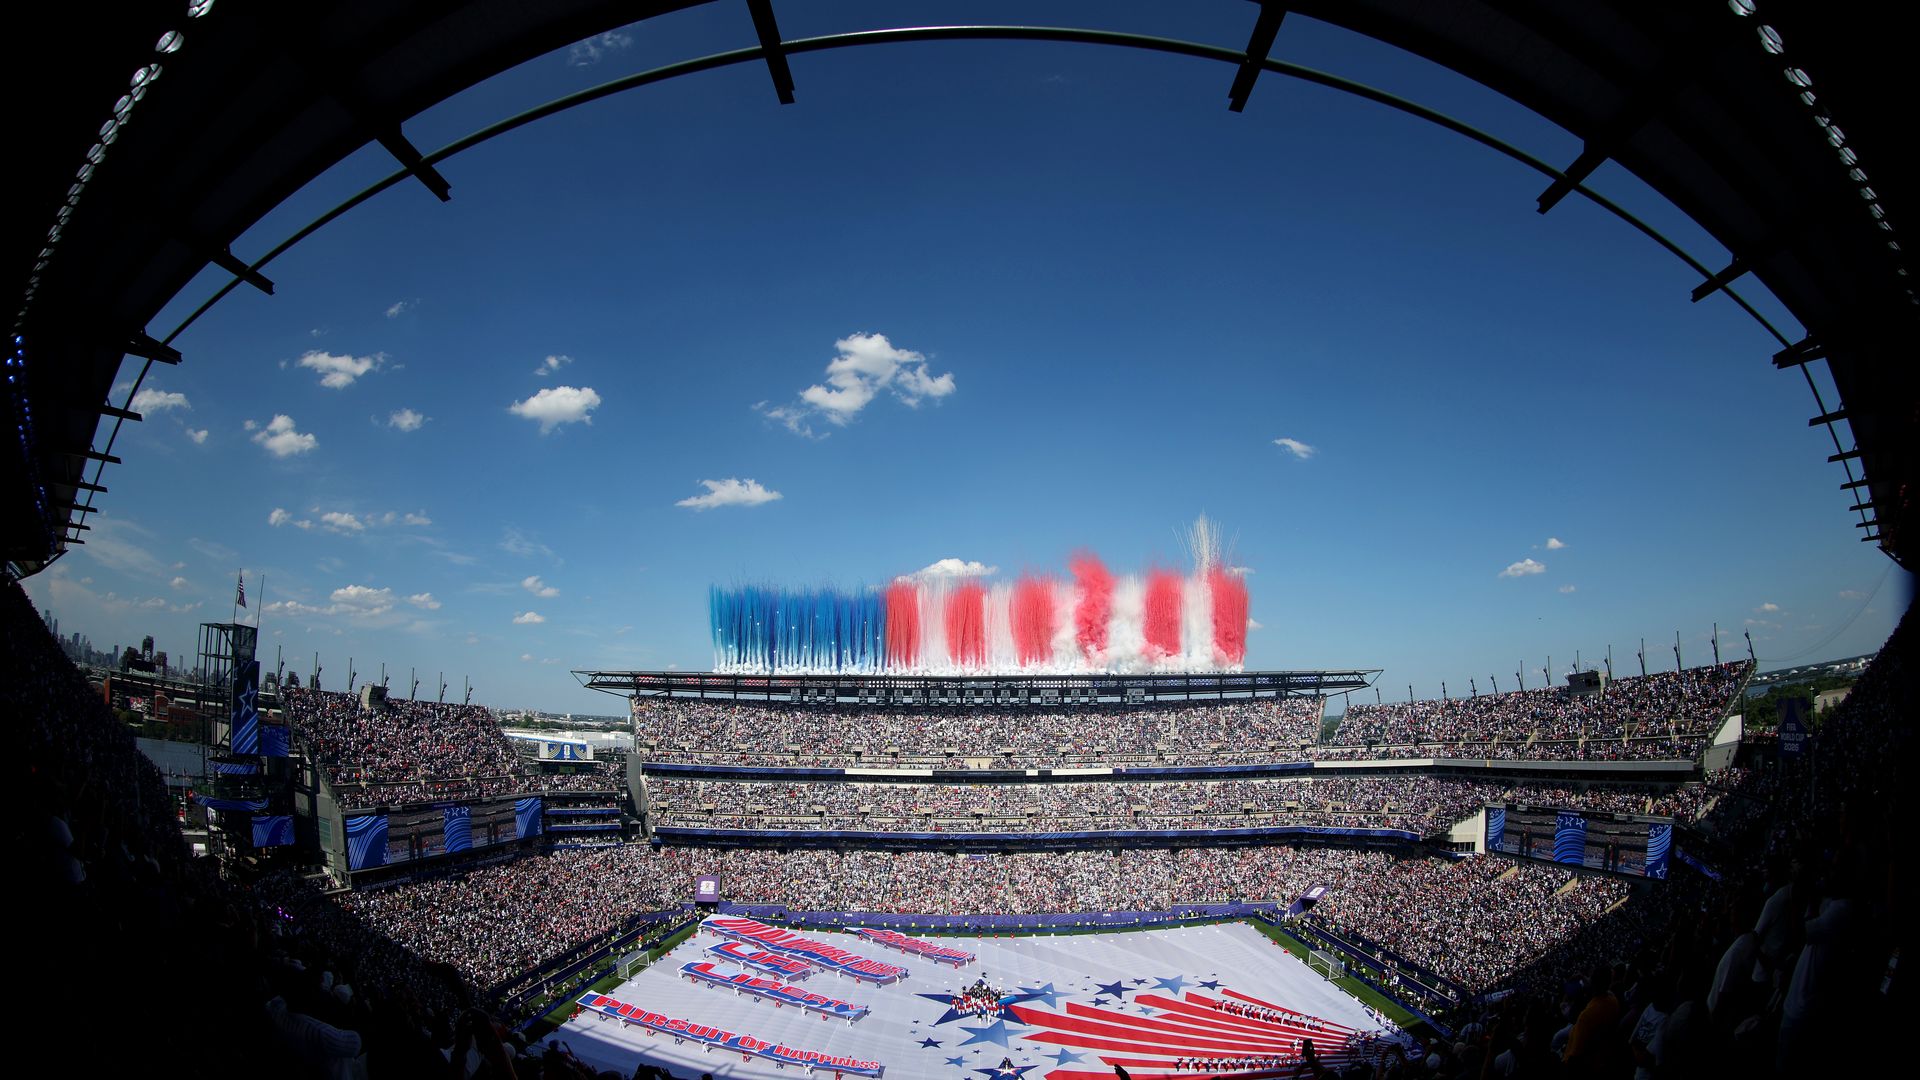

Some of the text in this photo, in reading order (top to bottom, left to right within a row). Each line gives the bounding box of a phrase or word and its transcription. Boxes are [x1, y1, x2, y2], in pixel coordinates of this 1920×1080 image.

[713, 919, 863, 965] UNALIENABLE
[719, 941, 811, 973] LIFE
[692, 962, 865, 1011] LIBERTY
[590, 995, 881, 1070] PURSUIT OF HAPPINESS
